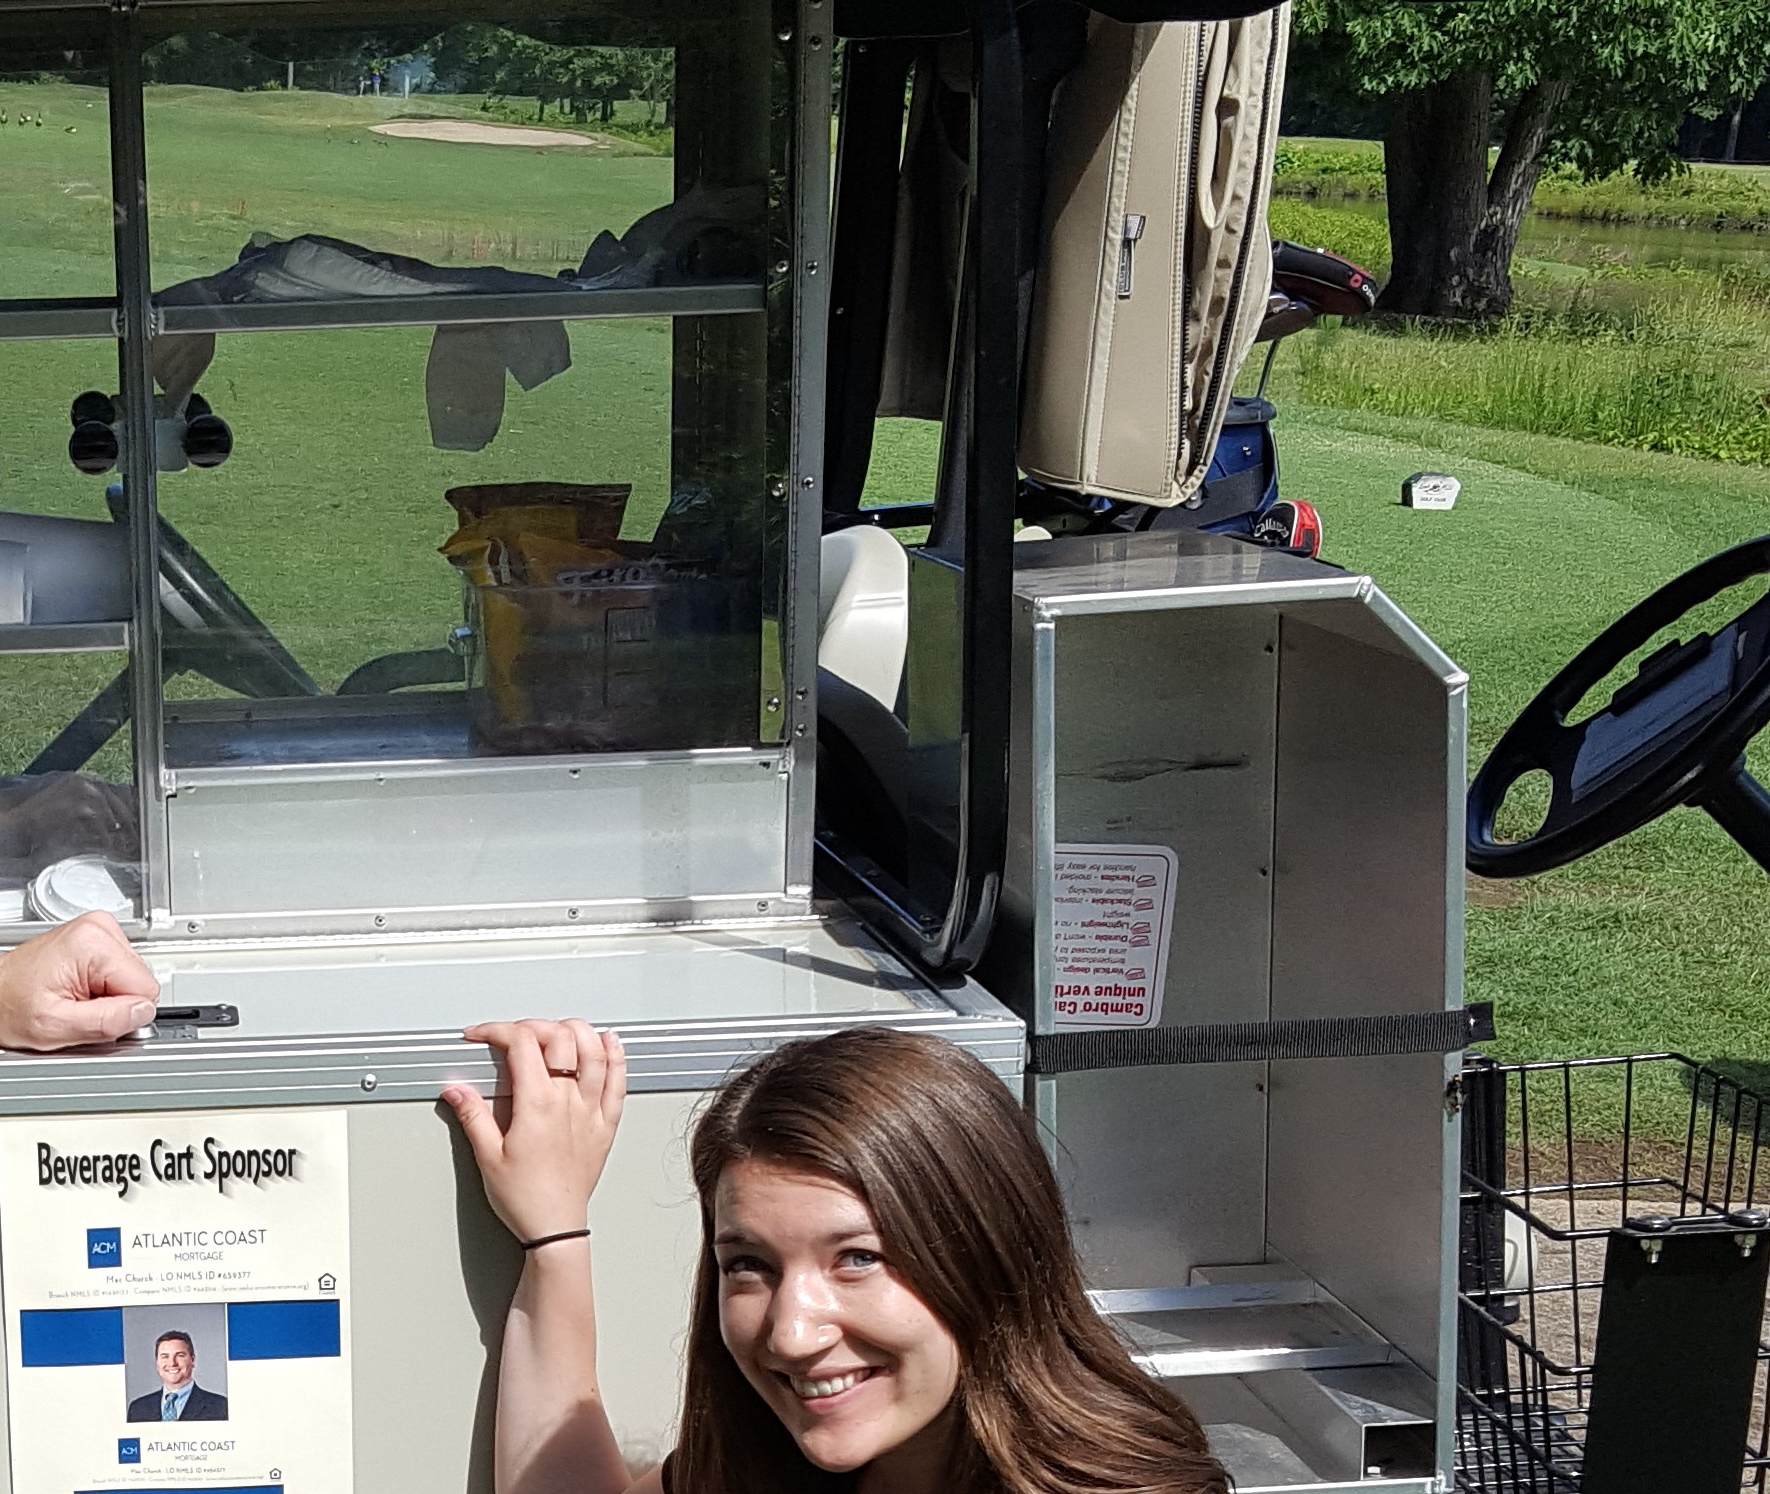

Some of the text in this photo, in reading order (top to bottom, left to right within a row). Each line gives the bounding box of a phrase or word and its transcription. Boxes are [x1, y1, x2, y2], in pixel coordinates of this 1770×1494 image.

[1094, 985, 1145, 999] unique
[1083, 1001, 1144, 1016] Cambro
[37, 1137, 298, 1198] Beverage Cart Sponsor
[132, 1229, 267, 1249] ATLANTIC COAST
[92, 1242, 117, 1254] ACM
[174, 1251, 224, 1262] MORTGAGE
[176, 1271, 203, 1280] NMLS
[206, 1270, 215, 1280] ID
[147, 1440, 235, 1452] ATLANTIC COAST
